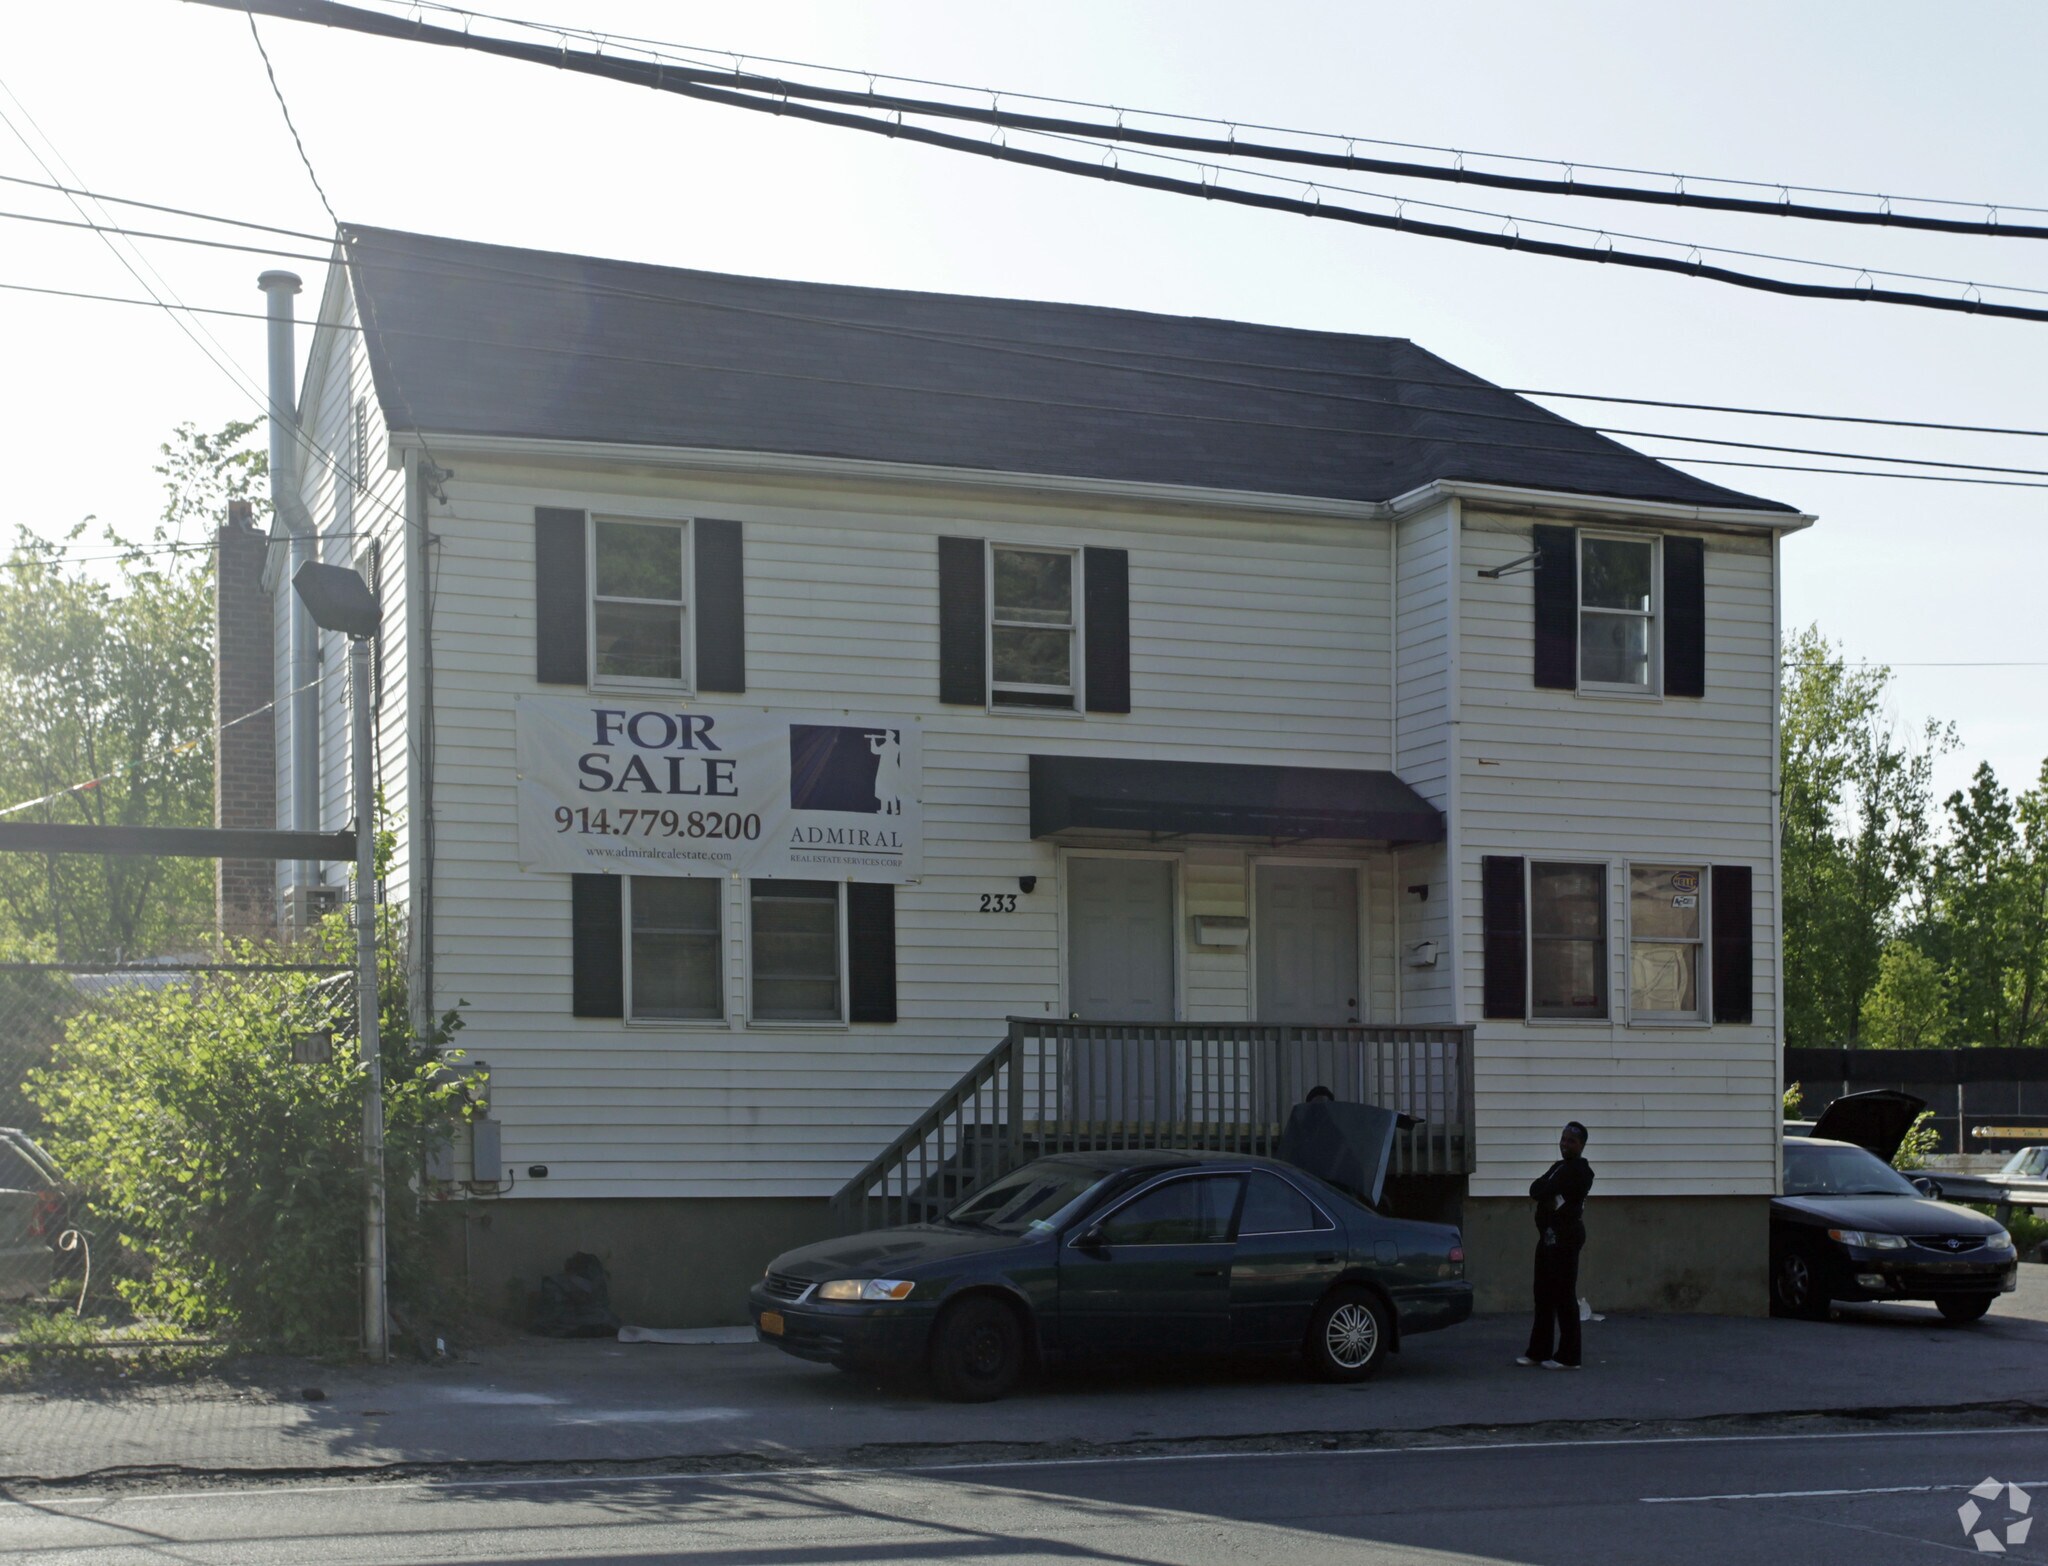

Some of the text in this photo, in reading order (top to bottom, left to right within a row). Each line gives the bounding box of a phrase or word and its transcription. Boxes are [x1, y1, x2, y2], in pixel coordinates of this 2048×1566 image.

[590, 708, 722, 751] FOR
[578, 752, 739, 797] SALE
[554, 806, 761, 840] 914.779.8200
[790, 826, 903, 848] ADMIRAL
[586, 846, 732, 861] www.admiralrealestate.com
[790, 854, 812, 863] REAL
[812, 855, 841, 864] ESTATE
[843, 857, 880, 866] SERVICES
[979, 893, 1017, 913] 233
